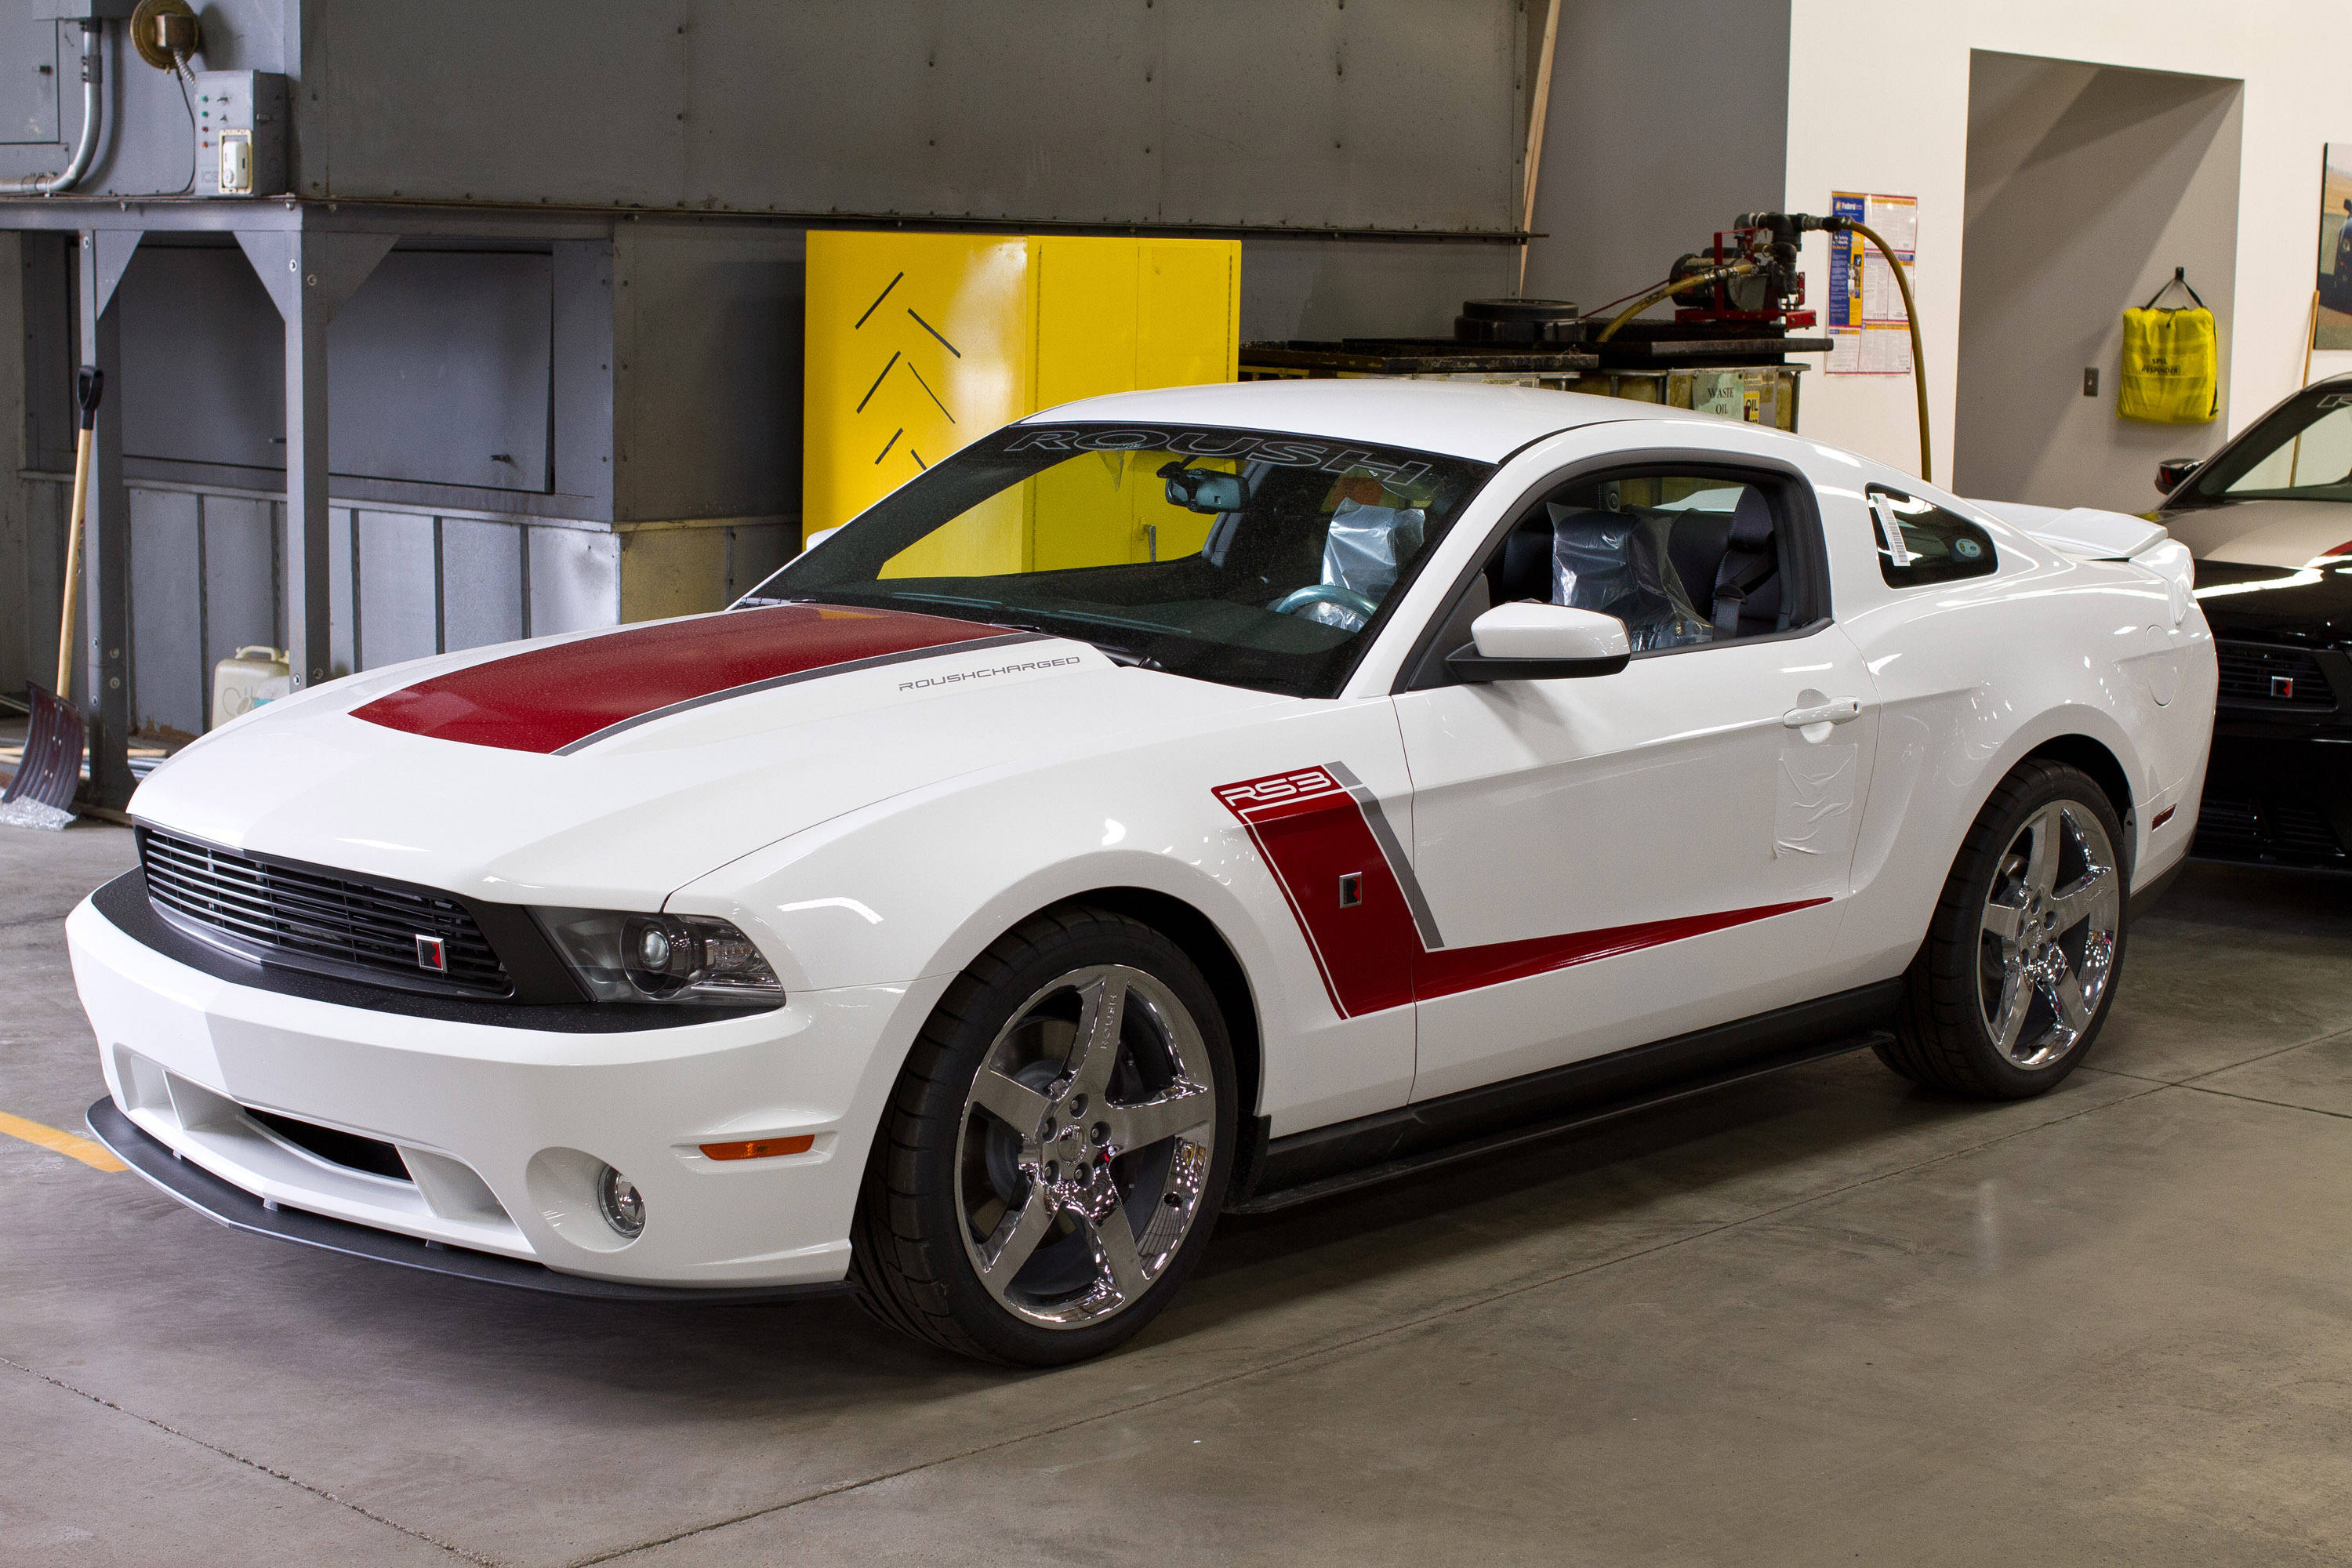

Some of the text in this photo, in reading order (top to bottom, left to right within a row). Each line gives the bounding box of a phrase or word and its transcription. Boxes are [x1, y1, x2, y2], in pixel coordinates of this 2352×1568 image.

[1708, 387, 1734, 398] WASTE
[1715, 404, 1728, 415] OIL
[1746, 399, 1759, 412] OIL
[1004, 430, 1433, 486] ROUSH
[898, 656, 1080, 691] ROUSHCHARGED
[1220, 771, 1331, 807] RS3
[1101, 995, 1117, 1049] ROUSH
